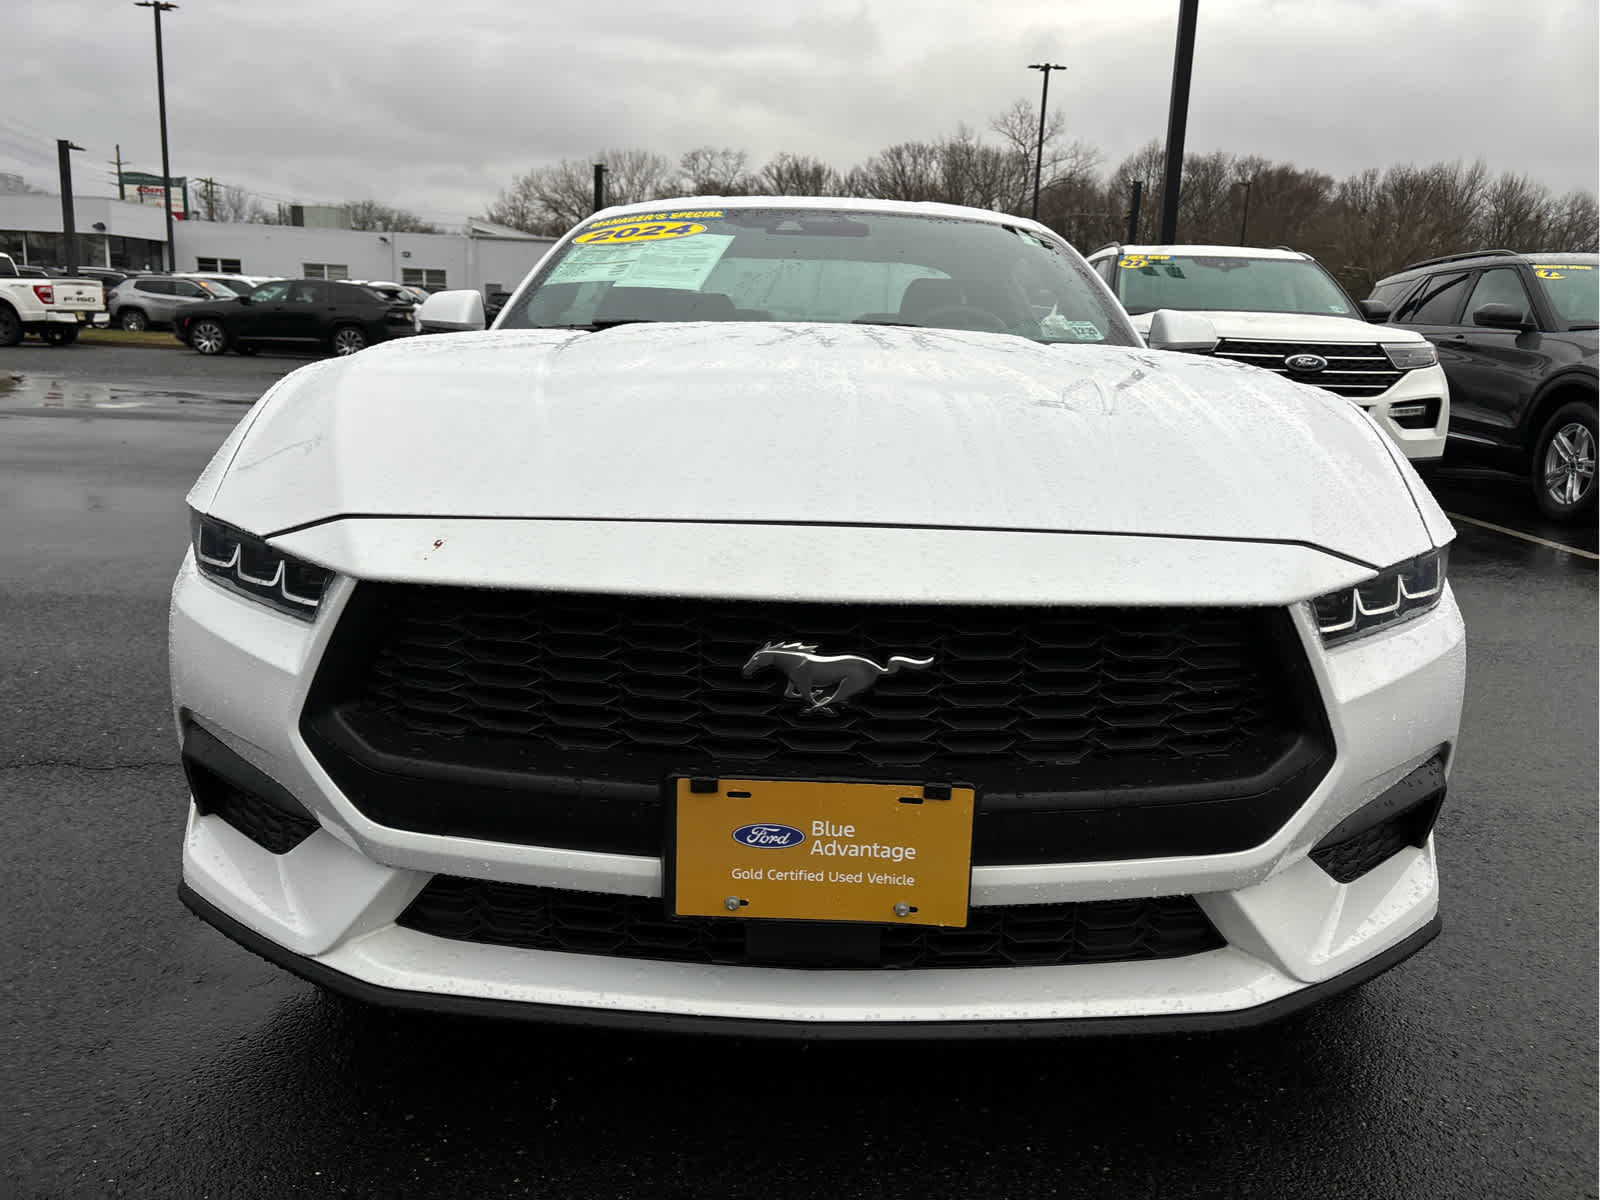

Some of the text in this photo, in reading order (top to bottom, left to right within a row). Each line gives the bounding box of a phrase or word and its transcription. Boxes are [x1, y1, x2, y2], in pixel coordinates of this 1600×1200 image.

[589, 210, 724, 229] MANAGER'S SPECIAL
[586, 224, 694, 242] 2024
[63, 296, 97, 304] F-150
[746, 826, 792, 846] Ford
[811, 820, 856, 838] Blue
[810, 839, 917, 863] Advantage
[731, 868, 916, 887] Gold Certified Used Vehicle
